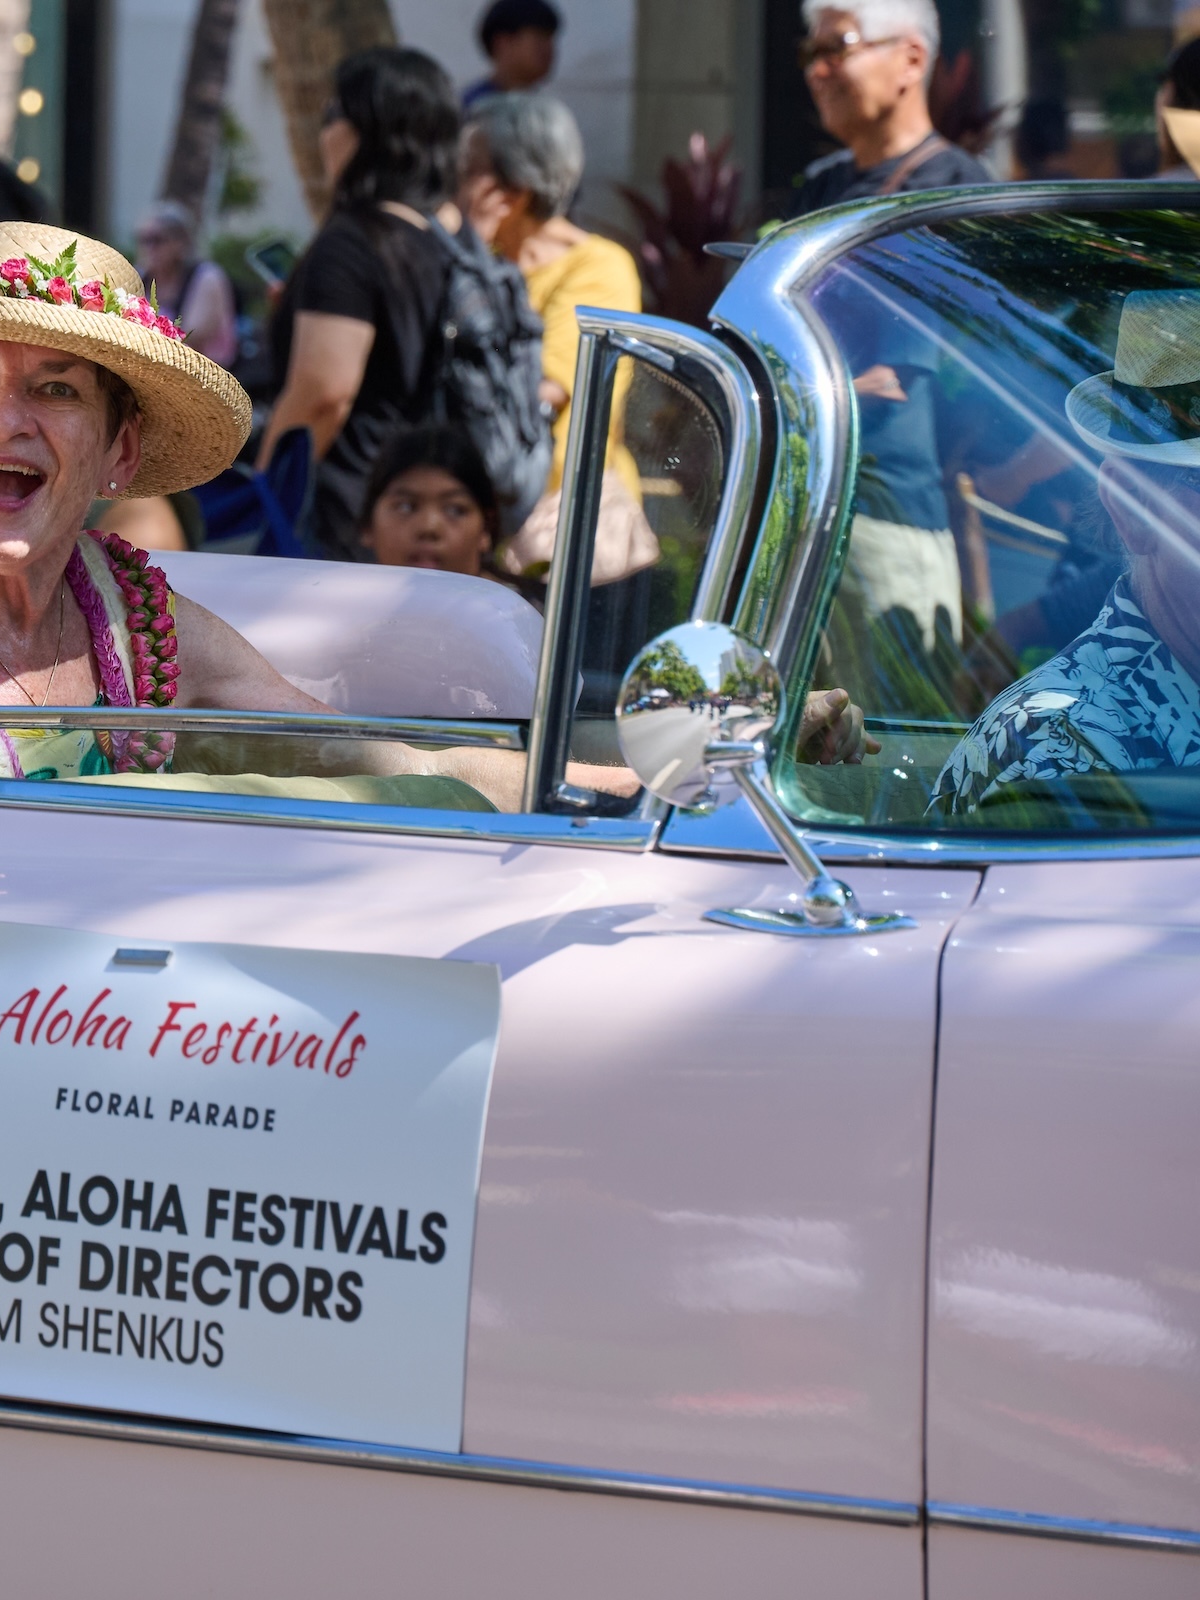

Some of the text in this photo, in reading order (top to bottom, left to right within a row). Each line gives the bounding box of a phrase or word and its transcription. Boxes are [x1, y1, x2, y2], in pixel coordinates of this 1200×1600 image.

[149, 1001, 366, 1078] Festivals
[55, 1087, 276, 1132] FLORAL PARADE
[20, 1169, 188, 1236] ALOHA
[204, 1187, 448, 1265] FESTIVALS
[78, 1240, 364, 1323] DIRECTORS
[38, 1301, 224, 1368] SHENKUS
